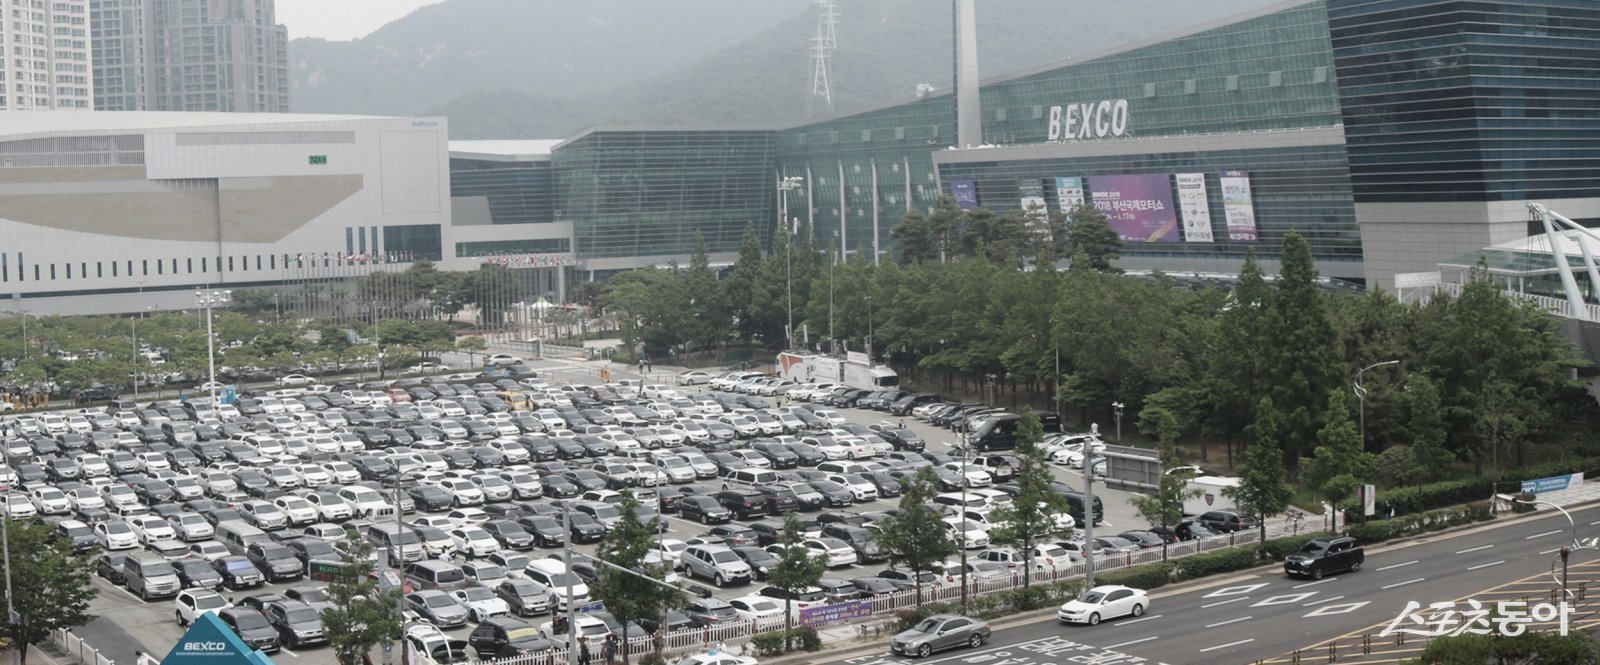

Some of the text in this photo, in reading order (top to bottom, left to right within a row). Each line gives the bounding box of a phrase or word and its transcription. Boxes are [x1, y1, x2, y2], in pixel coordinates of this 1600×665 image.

[1048, 99, 1128, 140] BEXCO
[1094, 199, 1165, 211] 2018 부산국제모터쇼
[184, 641, 226, 651] BEXCO
